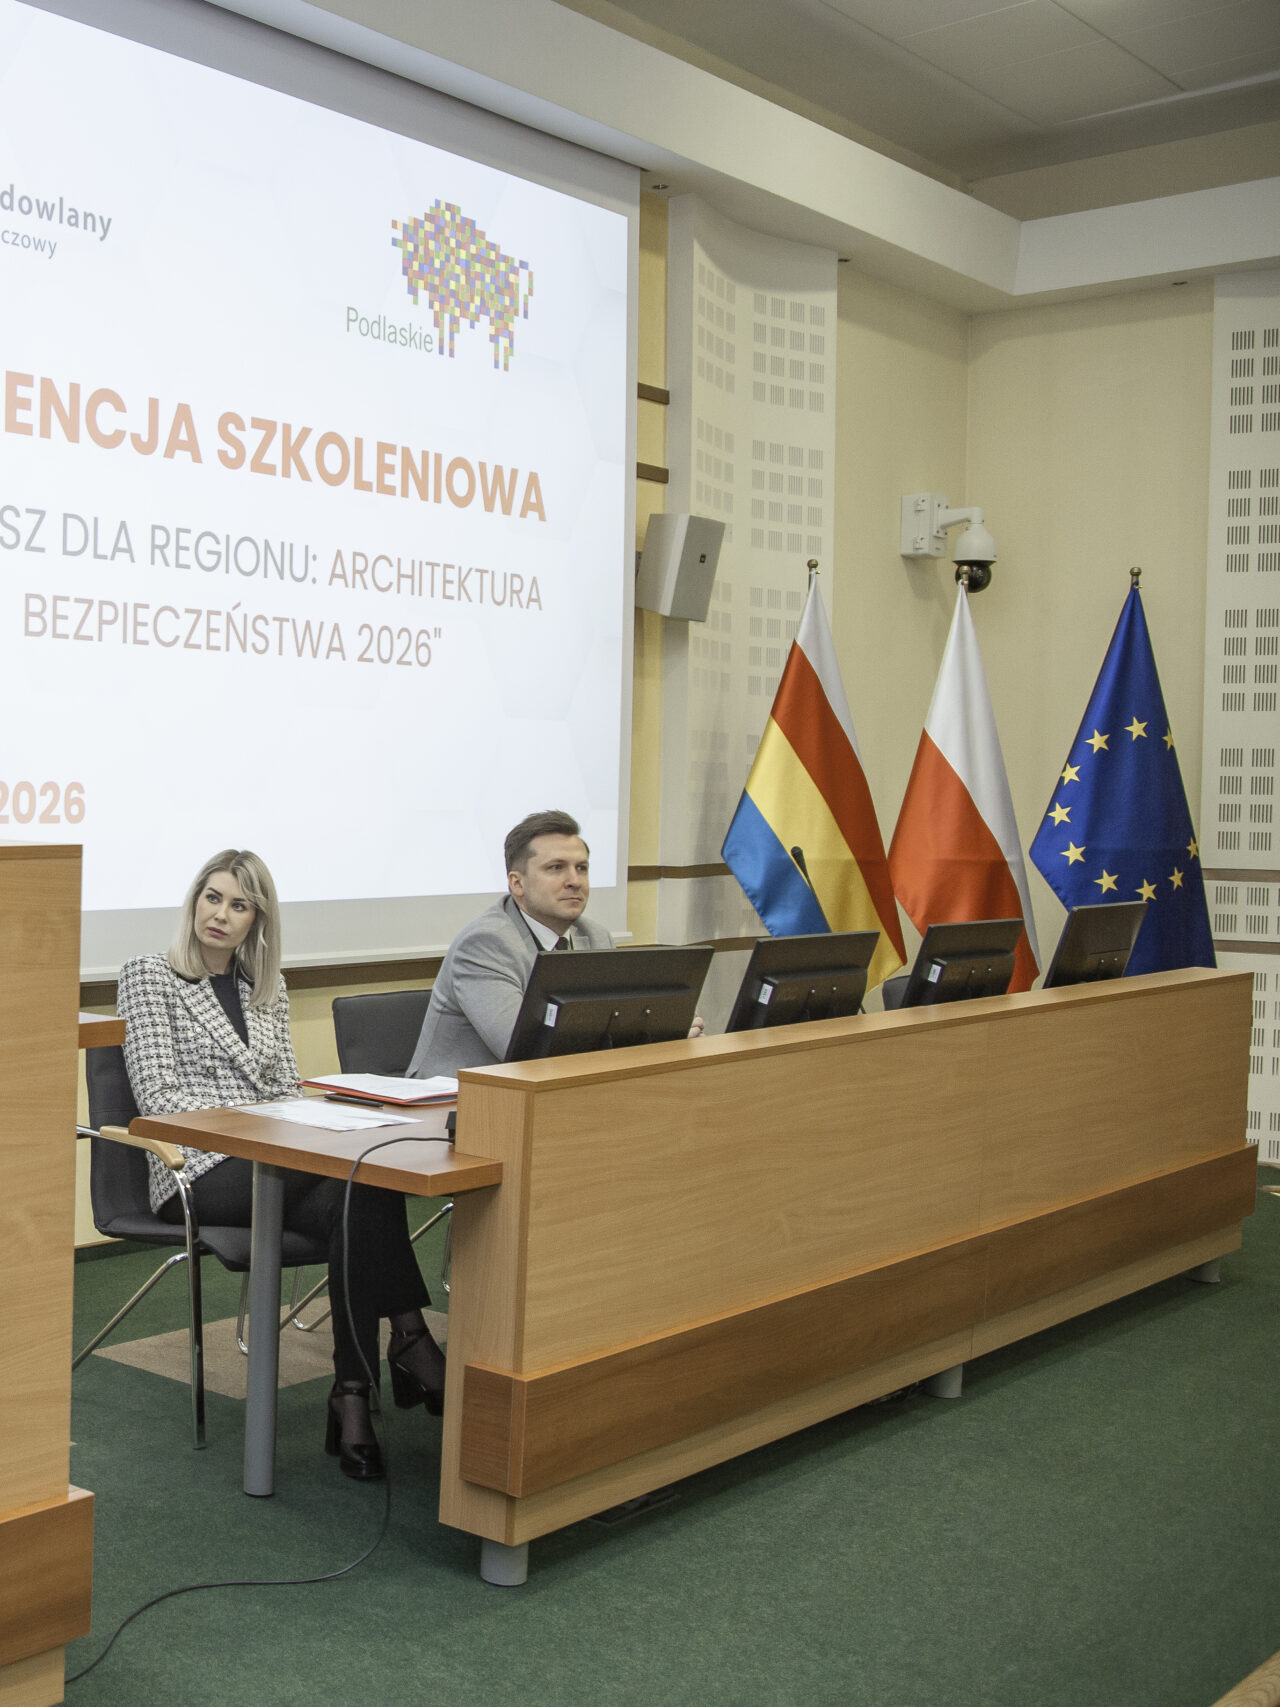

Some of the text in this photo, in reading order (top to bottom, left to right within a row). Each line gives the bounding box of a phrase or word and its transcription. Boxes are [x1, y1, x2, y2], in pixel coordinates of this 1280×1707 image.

[346, 305, 433, 353] Podlaskie
[217, 411, 547, 523] SZKOLENIOWA
[61, 512, 136, 564] DLA
[150, 523, 318, 585] REGIONU:
[327, 549, 543, 611] ARCHITEKTURA
[23, 592, 347, 662] BEZPIECZEŃSTWA
